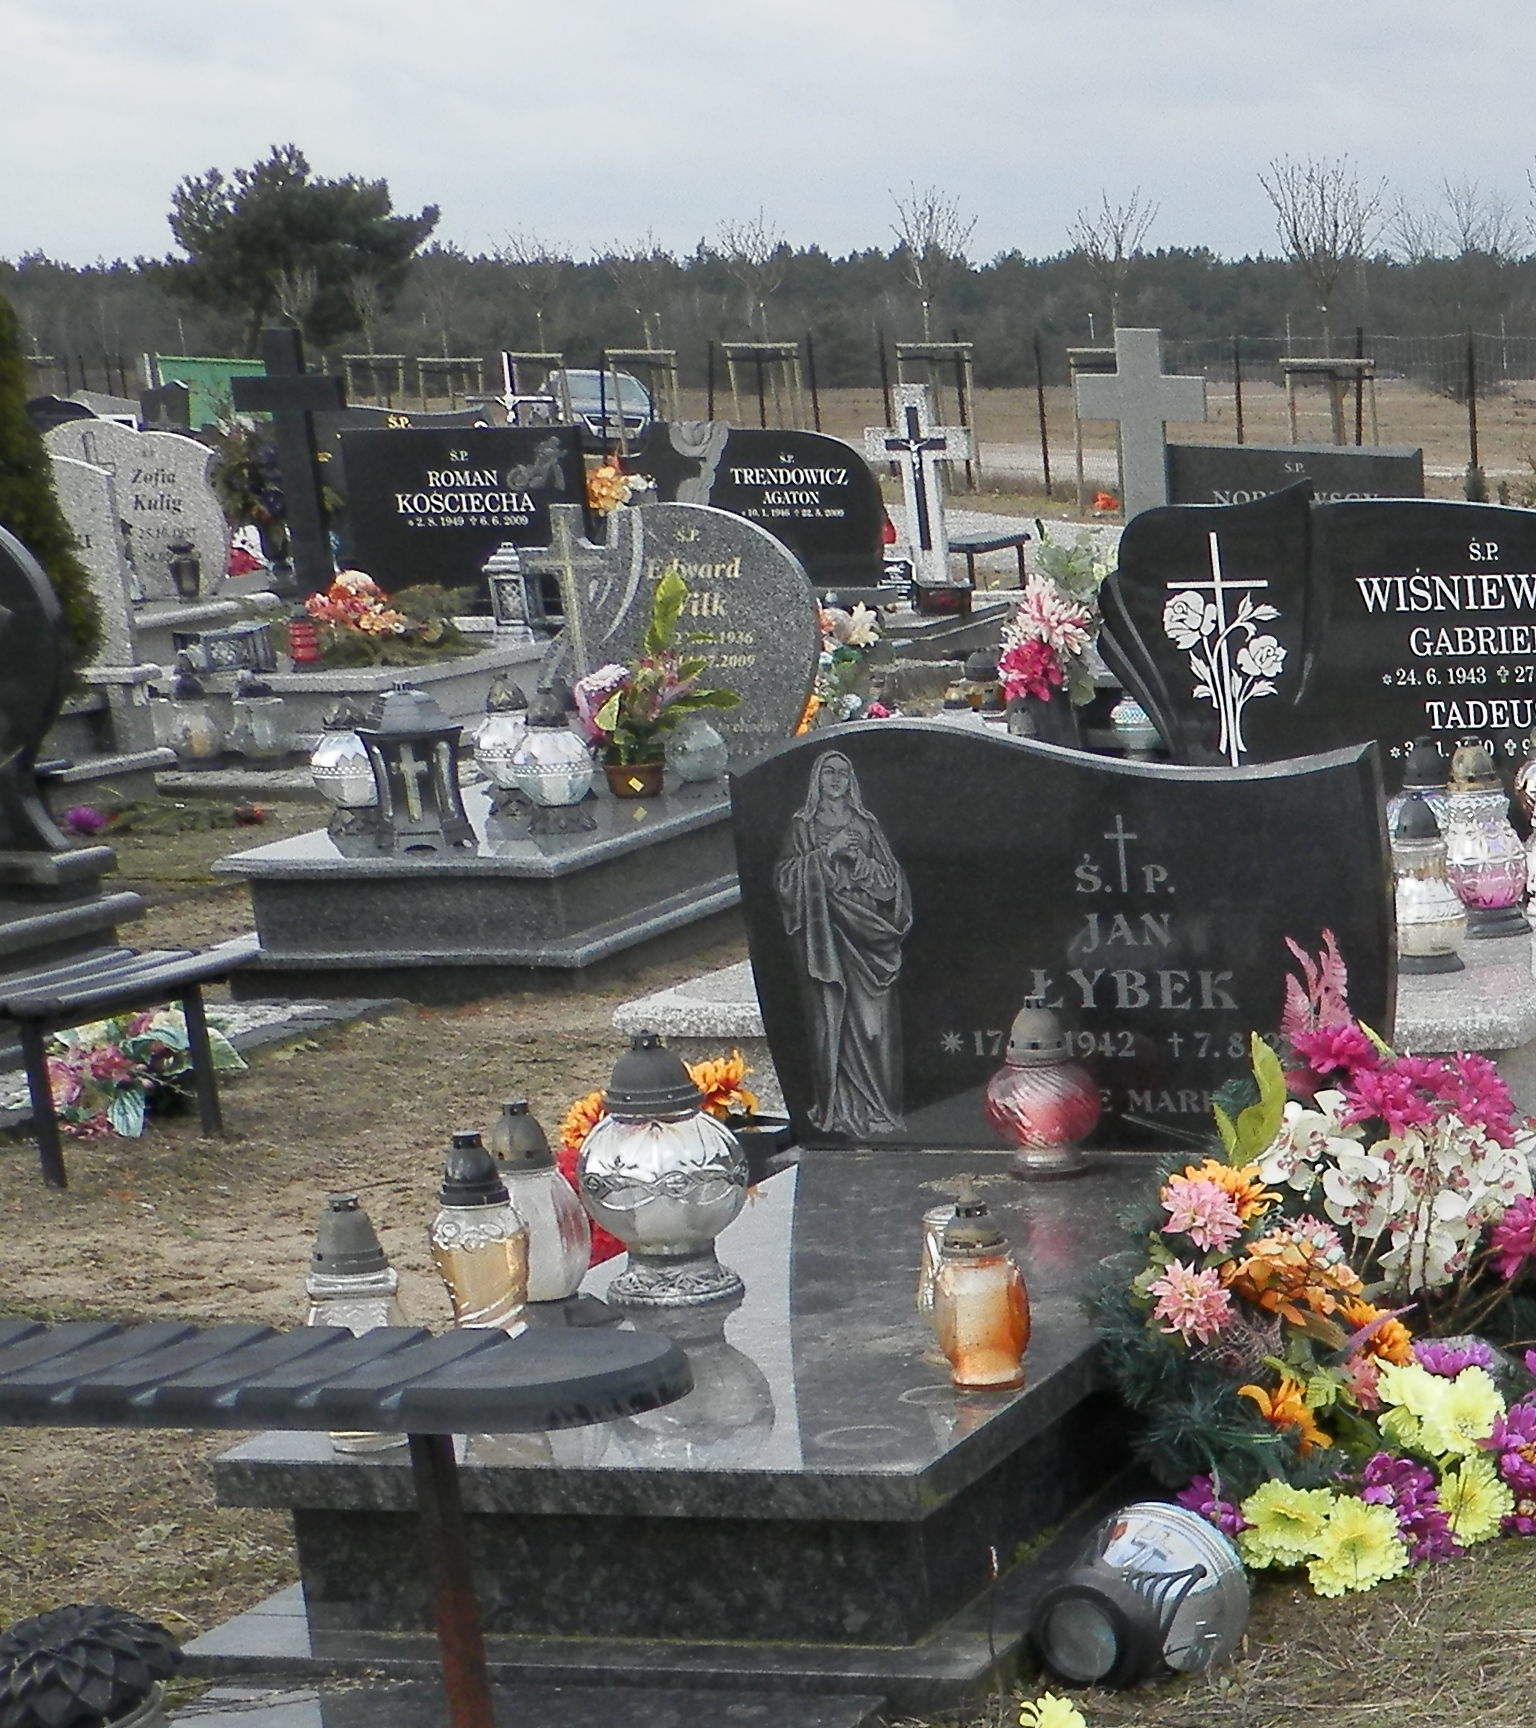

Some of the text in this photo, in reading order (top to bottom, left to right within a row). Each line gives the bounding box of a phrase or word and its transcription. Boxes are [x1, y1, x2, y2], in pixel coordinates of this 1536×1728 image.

[131, 469, 176, 486] Zofia
[426, 470, 499, 488] ROMAN
[729, 467, 849, 485] TRENDOWICZ
[133, 494, 183, 515] Kulig
[395, 490, 536, 514] KOŚCIECHA
[762, 490, 820, 505] AGATON
[1468, 537, 1499, 561] Ś.P.
[679, 591, 727, 618] ilk
[1141, 863, 1176, 893] P.
[1081, 912, 1173, 953] JAN
[1029, 968, 1239, 1010] ŁYBEK
